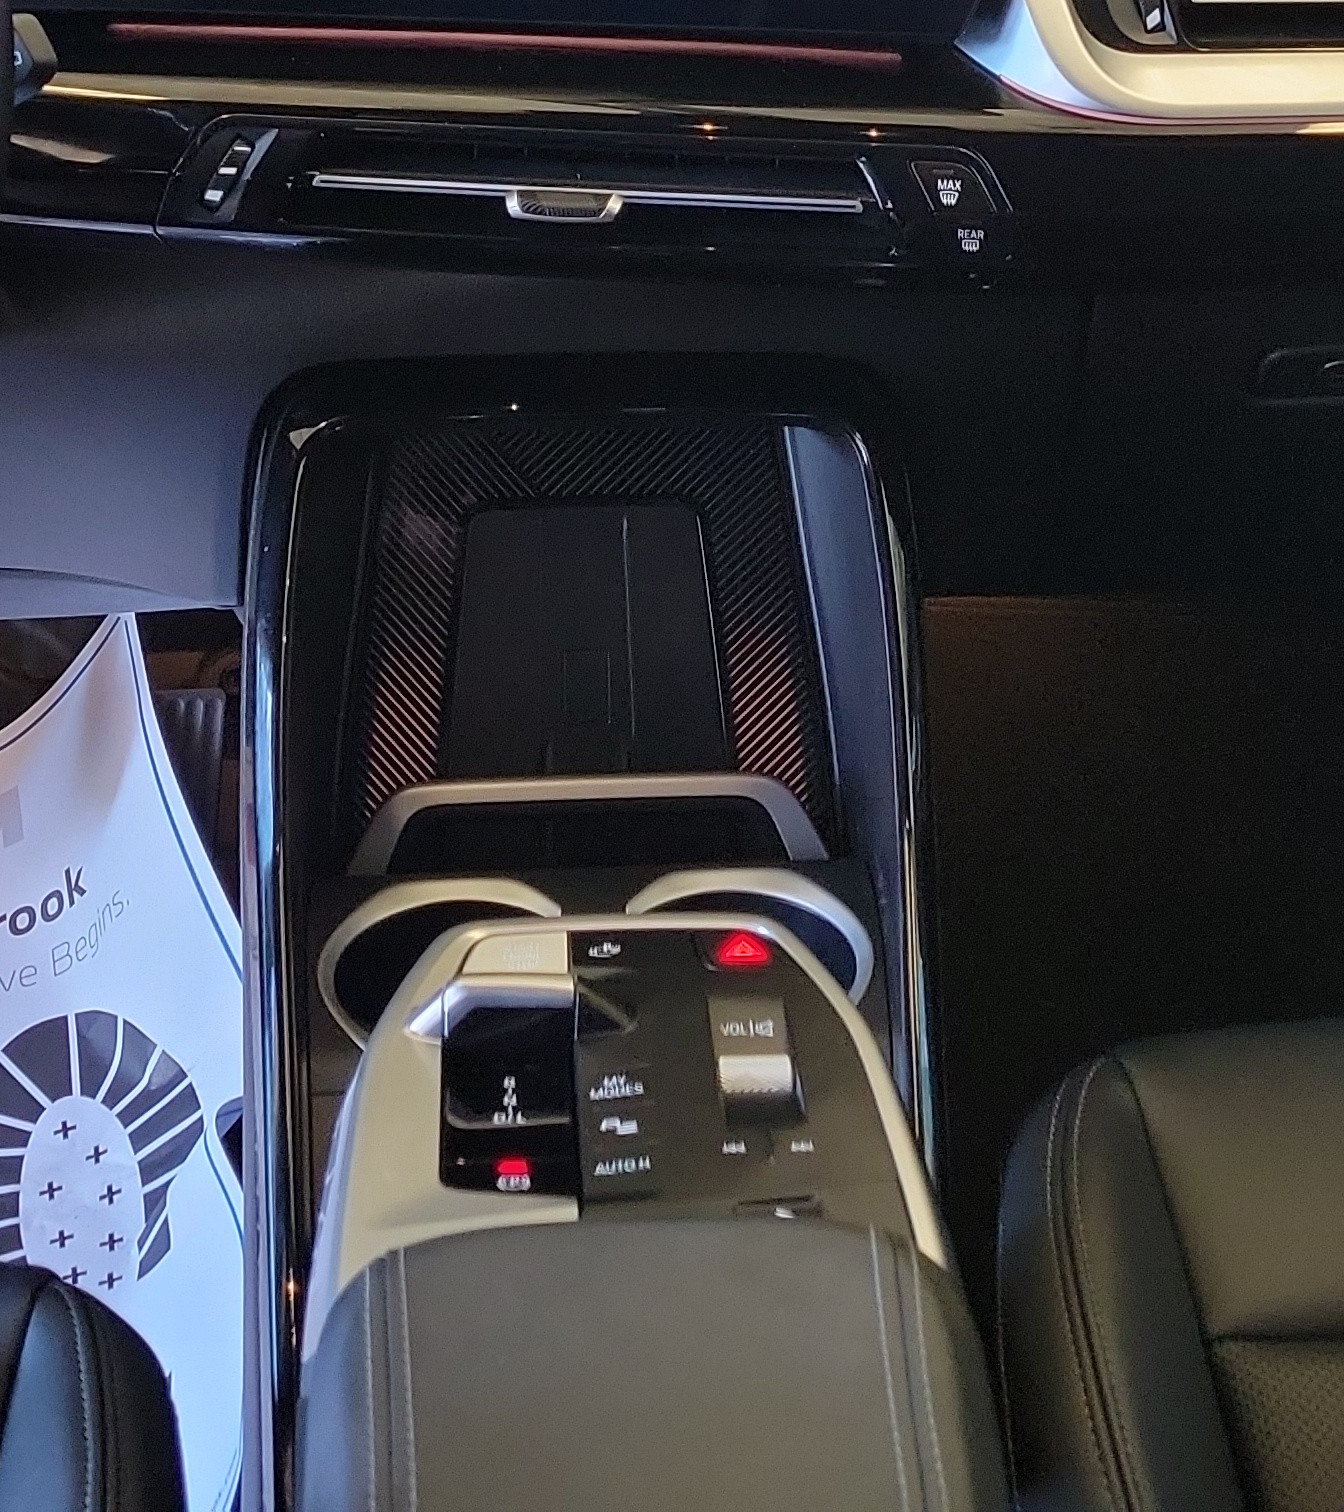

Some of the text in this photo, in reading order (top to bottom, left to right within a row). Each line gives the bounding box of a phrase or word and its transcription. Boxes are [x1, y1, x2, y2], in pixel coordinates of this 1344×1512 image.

[937, 178, 962, 192] MAX
[957, 228, 985, 241] REAR
[50, 889, 131, 978] Begins.
[719, 1021, 748, 1037] VOL
[593, 1157, 637, 1177] AUTO
